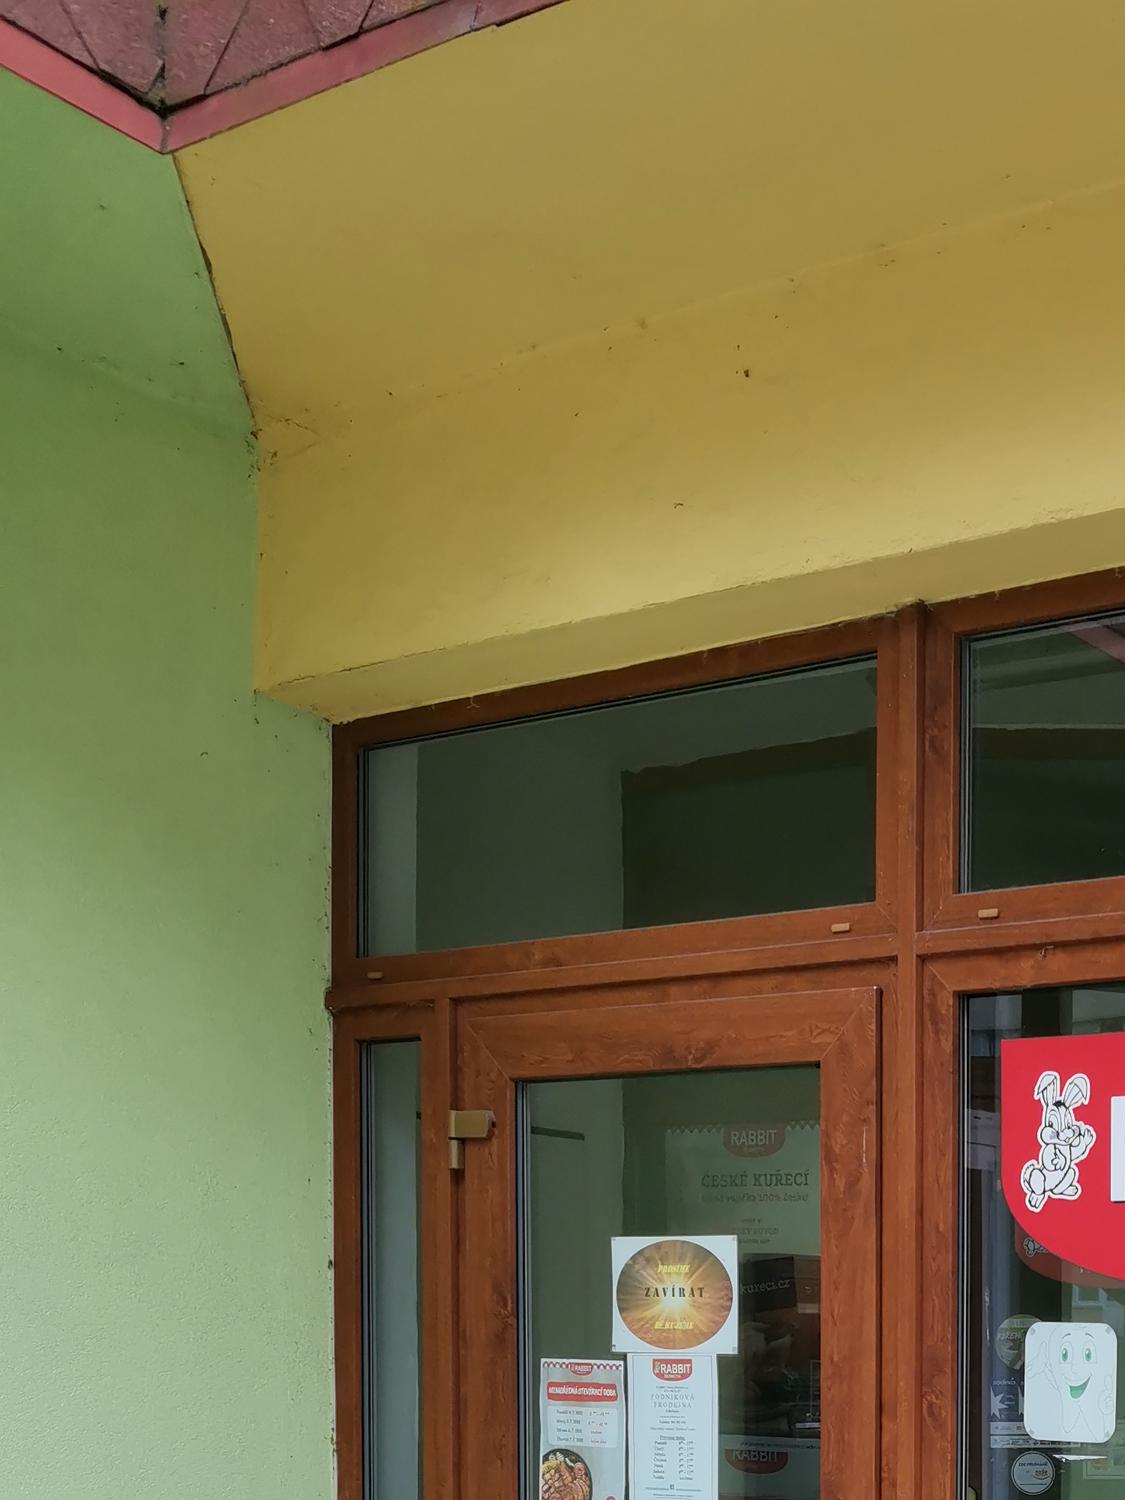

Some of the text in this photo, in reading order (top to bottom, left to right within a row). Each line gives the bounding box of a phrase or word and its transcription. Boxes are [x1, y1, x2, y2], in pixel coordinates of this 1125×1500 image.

[731, 1129, 777, 1145] RABBIT
[753, 1168, 810, 1187] KUŘECÍ
[644, 1284, 704, 1298] ZAVÍRAT
[660, 1363, 691, 1374] RABBIT
